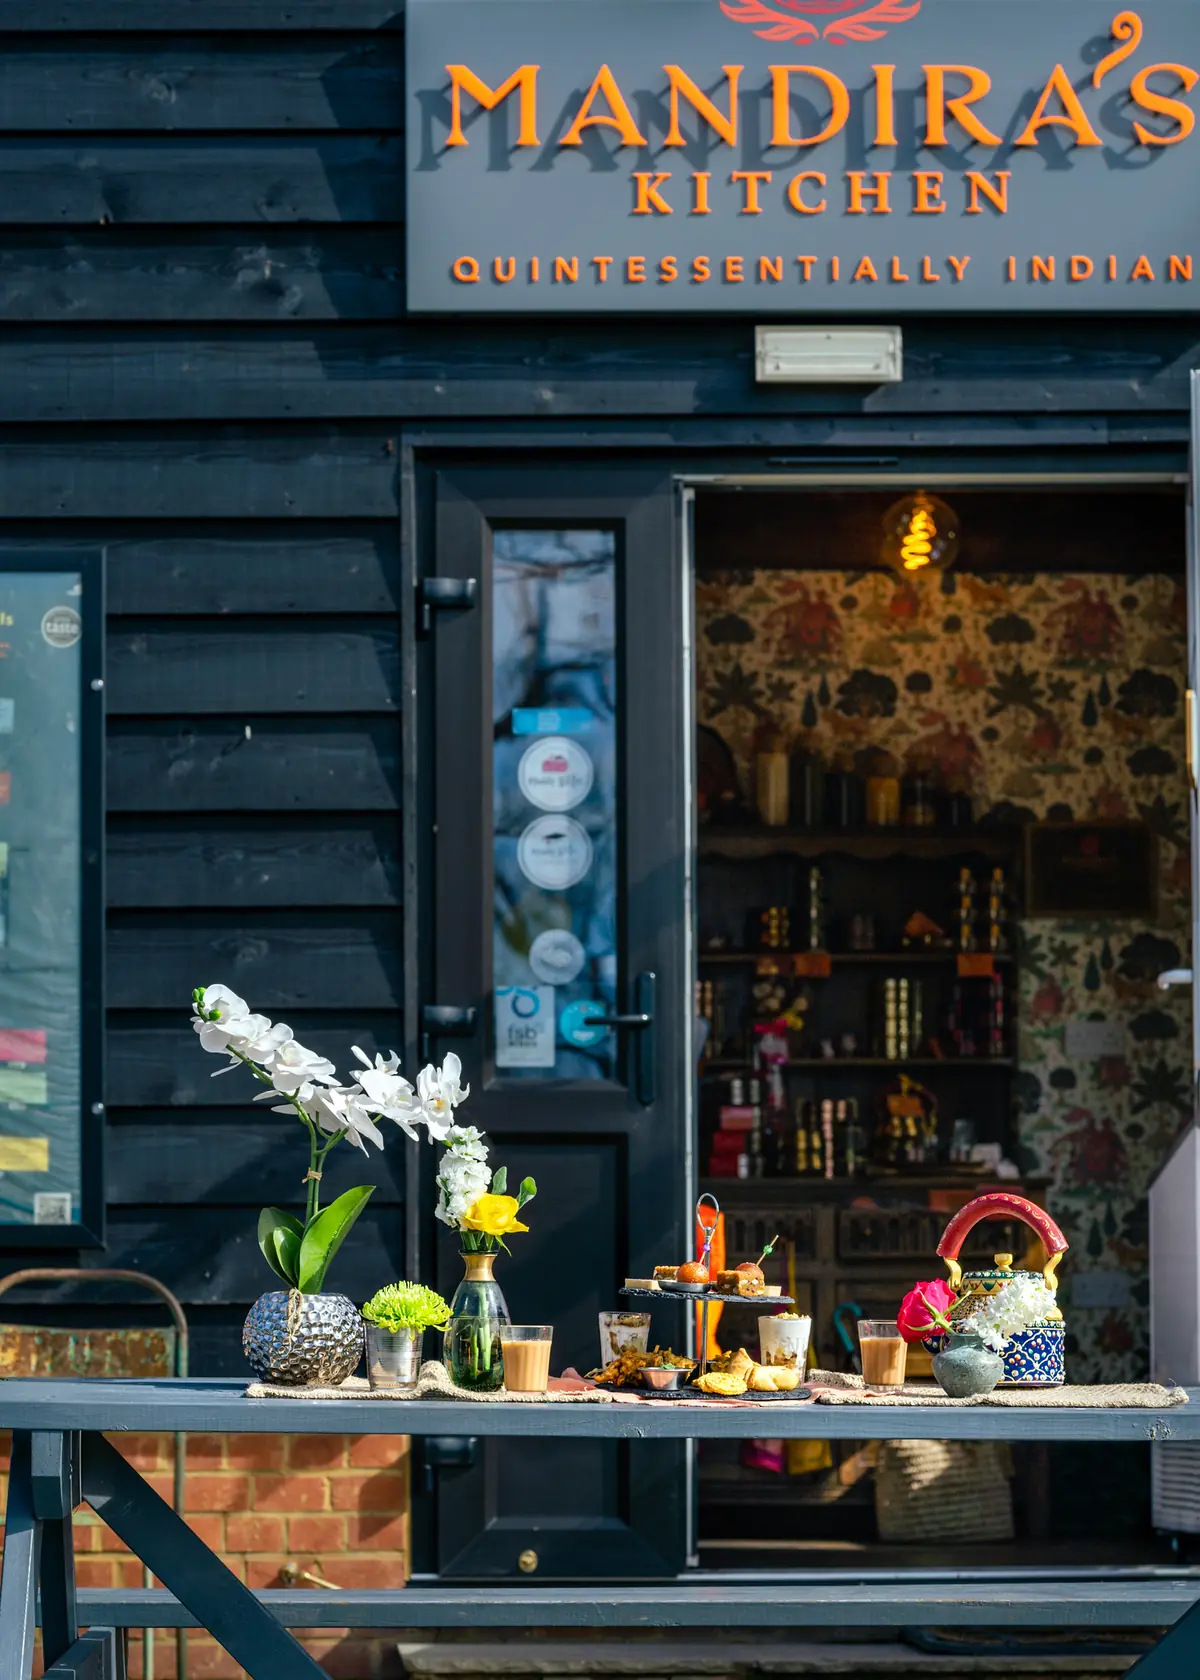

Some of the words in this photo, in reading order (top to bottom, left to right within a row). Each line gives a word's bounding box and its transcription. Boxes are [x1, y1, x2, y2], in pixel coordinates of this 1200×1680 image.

[446, 12, 1199, 147] MANDIRA'S
[632, 172, 1009, 214] KITCHEN
[453, 256, 969, 283] QUINTESSENTIALLY
[1008, 255, 1192, 281] INDIAN
